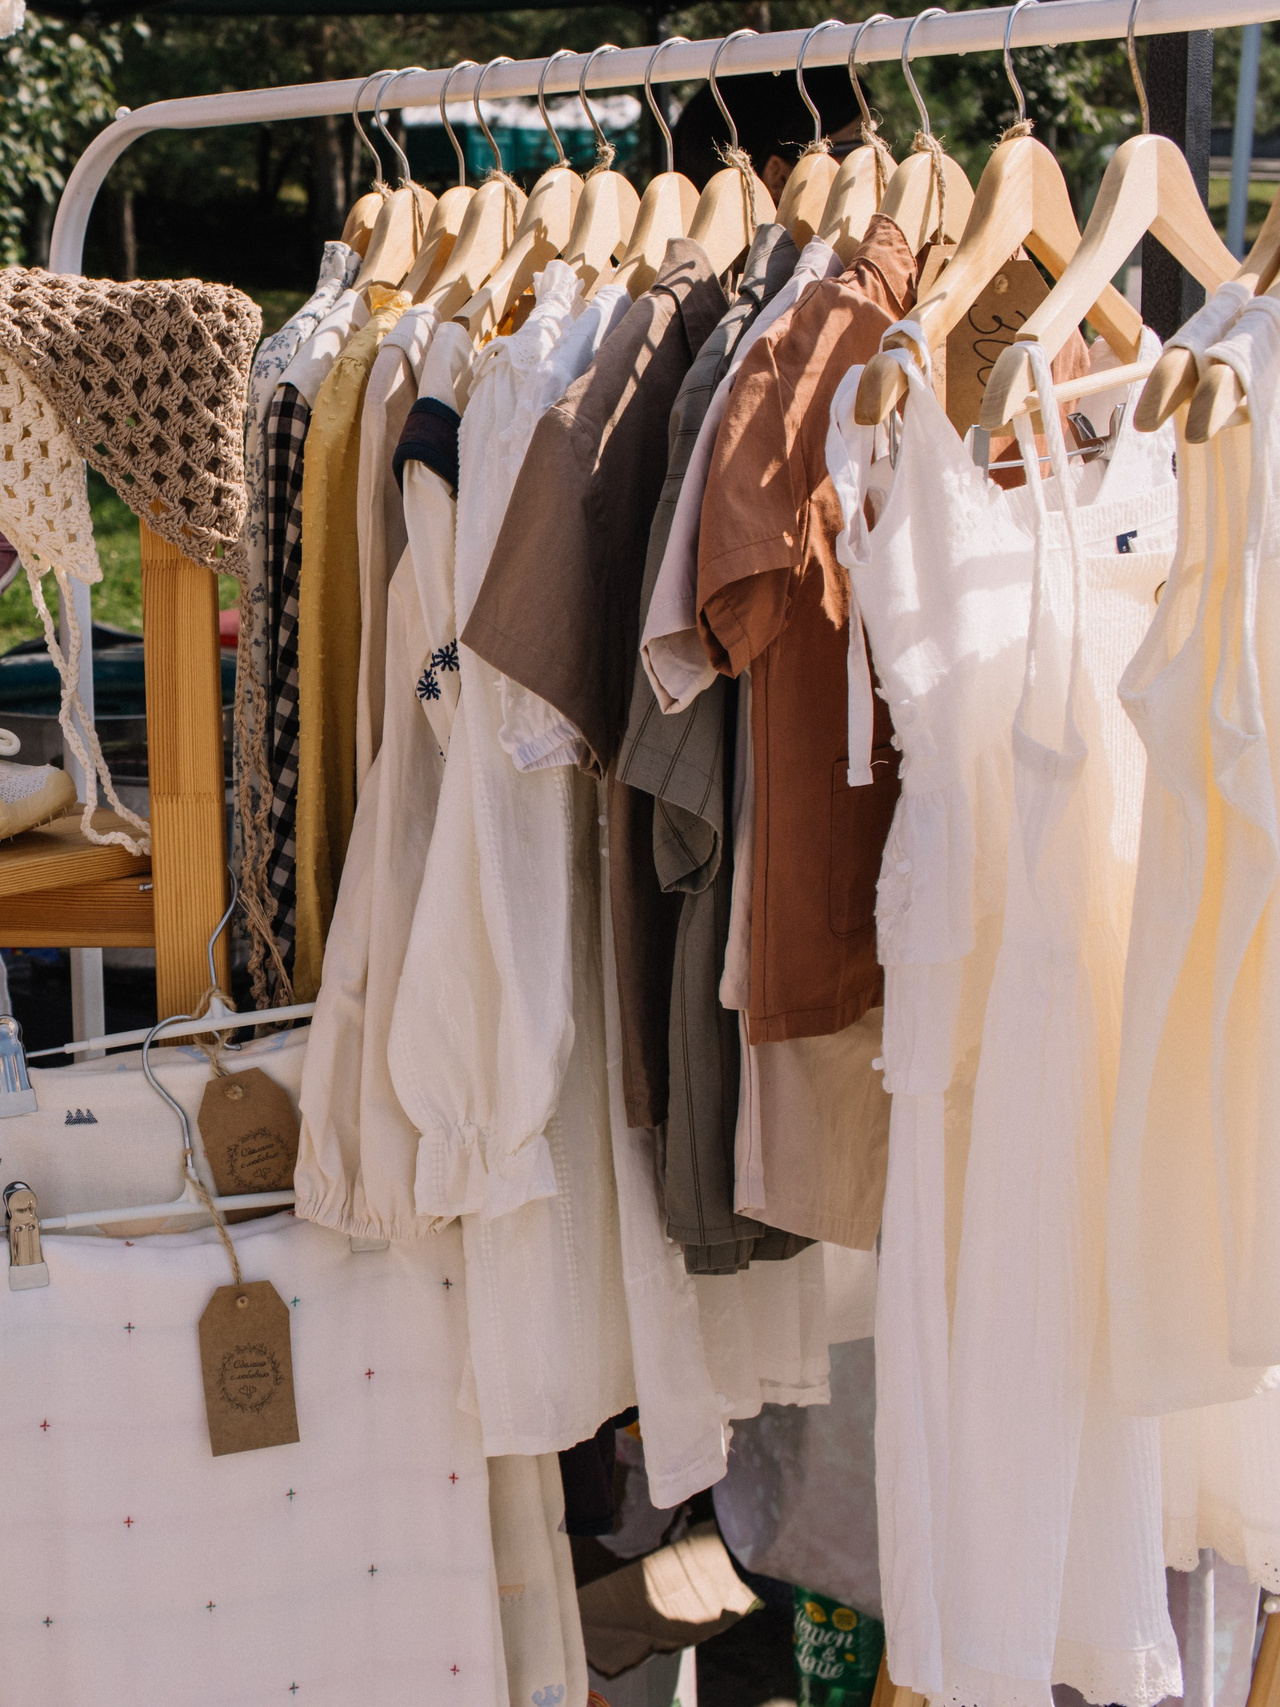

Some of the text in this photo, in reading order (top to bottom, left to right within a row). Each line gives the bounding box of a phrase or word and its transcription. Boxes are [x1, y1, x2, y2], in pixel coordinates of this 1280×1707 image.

[241, 1143, 274, 1158] Сделано
[246, 1151, 280, 1167] любовью
[233, 1359, 267, 1369] Сделано
[236, 1369, 270, 1380] любовью
[821, 1646, 837, 1662] &
